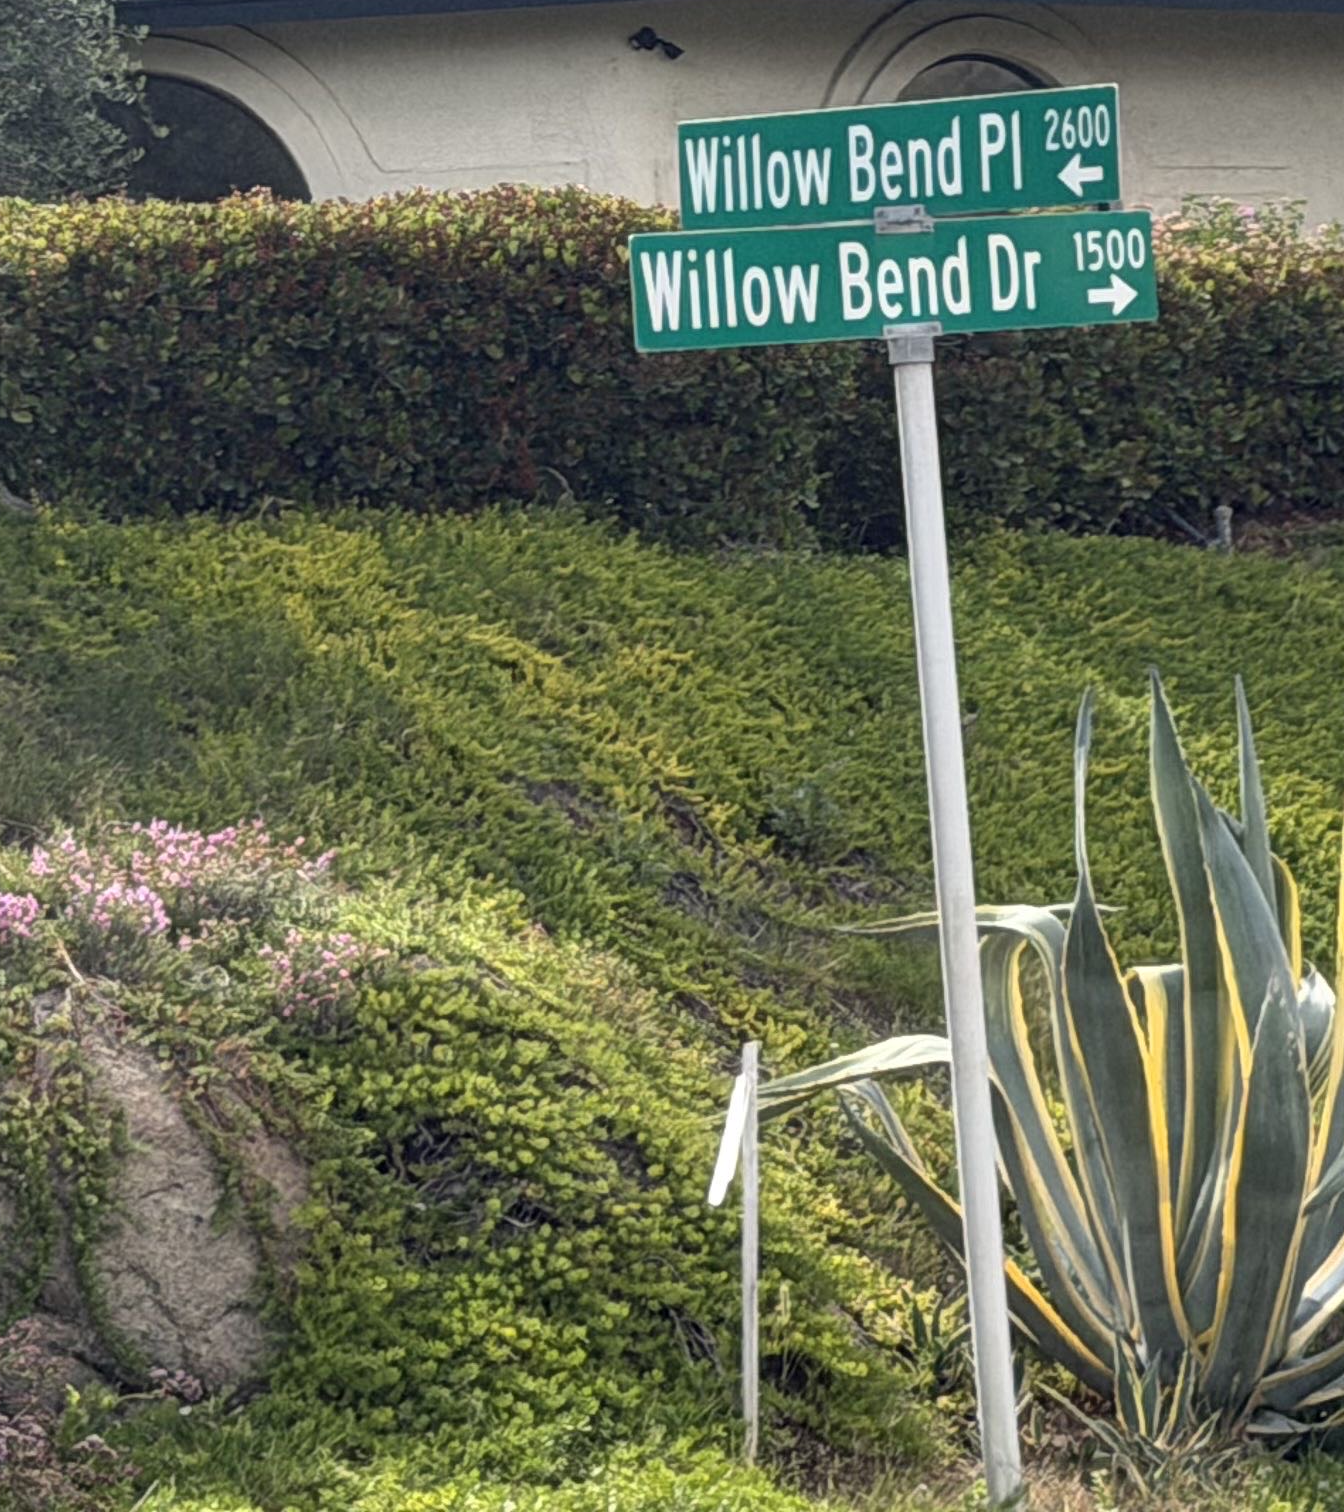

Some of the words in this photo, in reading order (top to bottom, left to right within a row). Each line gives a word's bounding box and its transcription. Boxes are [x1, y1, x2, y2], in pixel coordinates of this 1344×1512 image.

[685, 134, 832, 214] Willow
[848, 116, 962, 202] Bend
[979, 110, 1023, 192] Pl
[1044, 104, 1111, 151] 2600
[640, 248, 820, 332] Willow
[838, 236, 972, 320] Bend
[988, 233, 1041, 312] Dr
[1073, 229, 1145, 271] 1500
